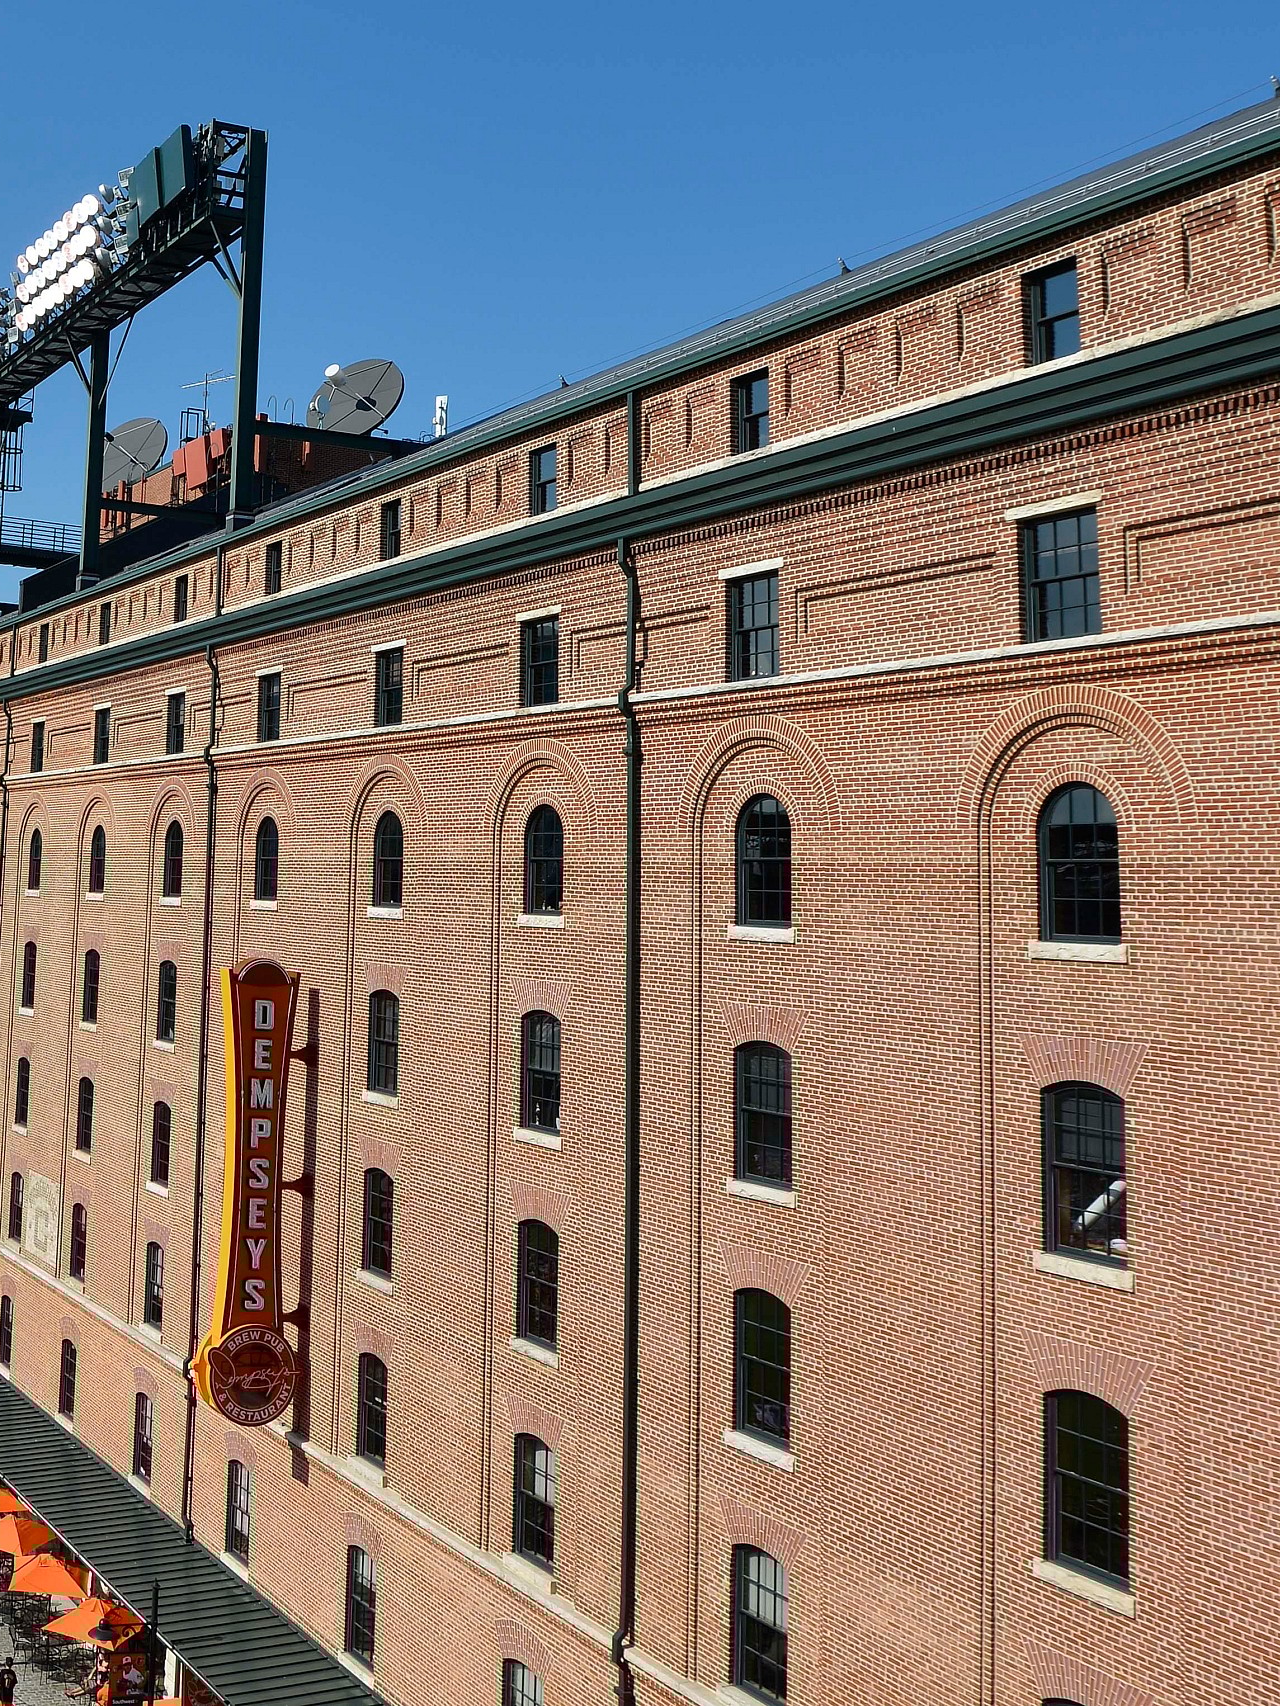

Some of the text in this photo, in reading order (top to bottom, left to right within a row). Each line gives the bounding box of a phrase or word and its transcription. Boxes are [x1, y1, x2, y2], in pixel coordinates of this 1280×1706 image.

[244, 999, 275, 1311] DEMPSEYS
[227, 1331, 284, 1352] BREW PUB
[219, 1382, 291, 1420] & RESTAURANT
